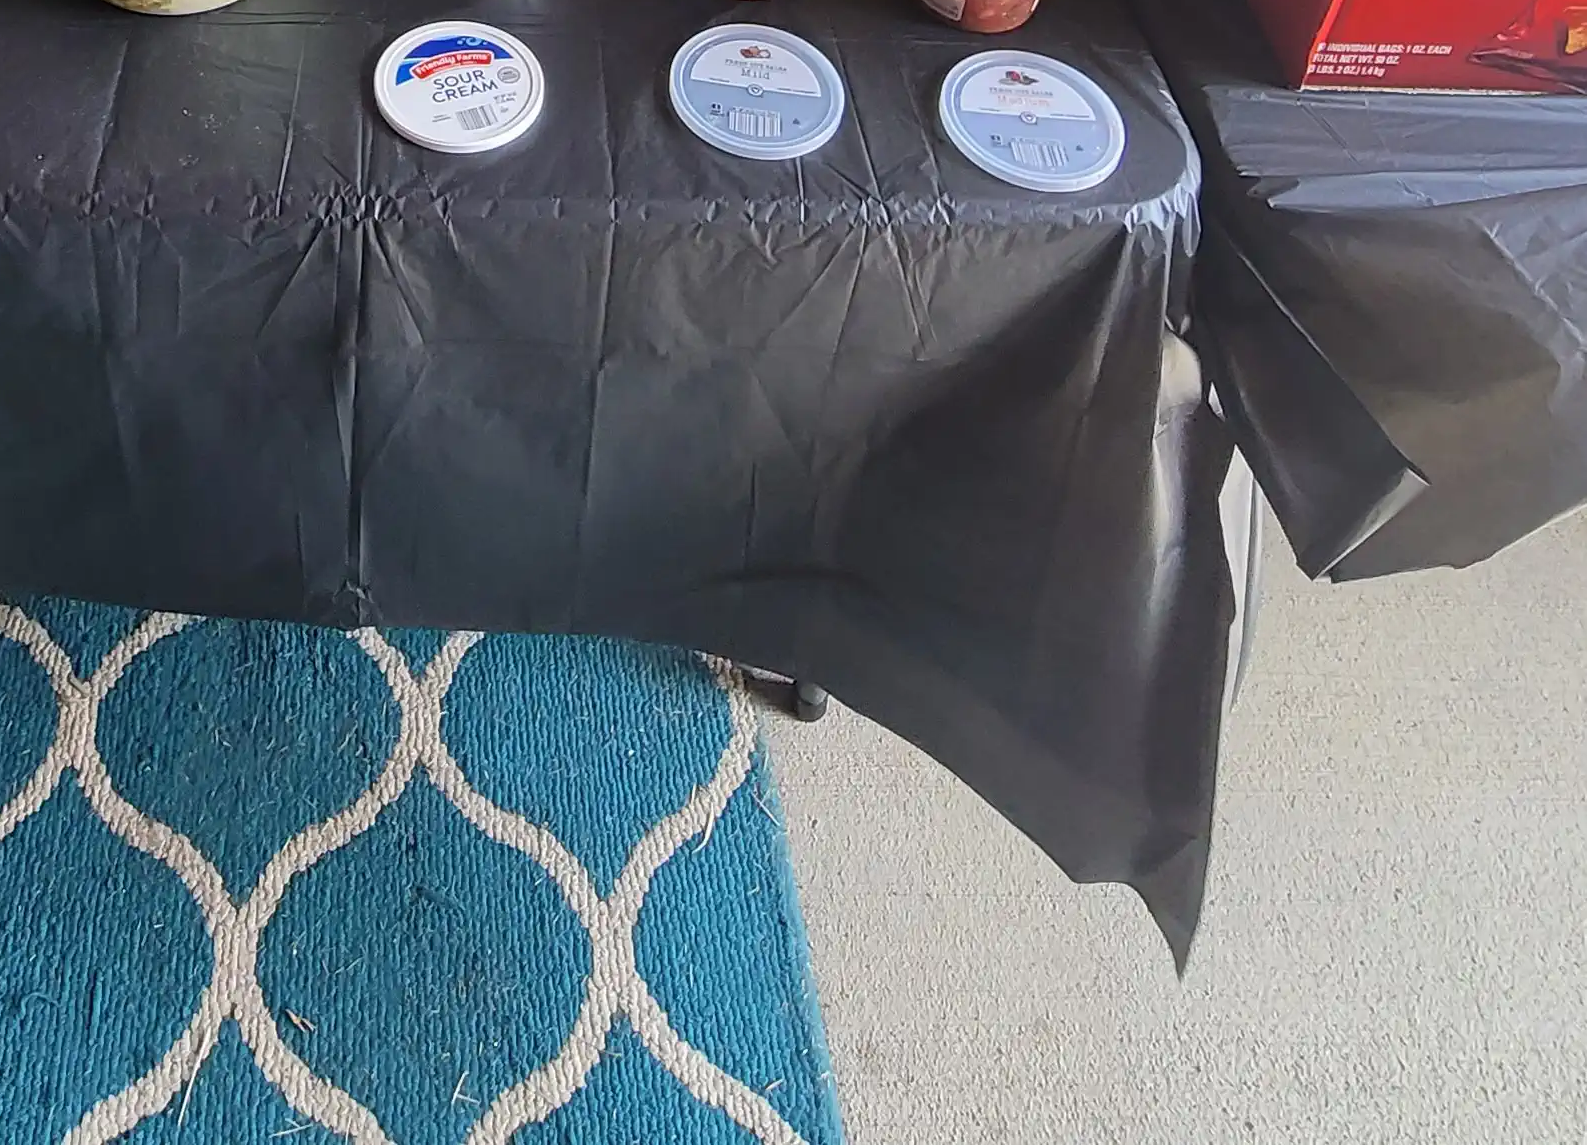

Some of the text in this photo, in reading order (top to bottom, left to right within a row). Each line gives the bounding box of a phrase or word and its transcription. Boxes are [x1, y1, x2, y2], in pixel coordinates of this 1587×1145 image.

[1327, 43, 1376, 52] INDIVIDUAL
[1427, 45, 1453, 55] EACH
[415, 53, 488, 75] Friendly Farms
[1312, 53, 1338, 63] TOTAL
[1339, 54, 1358, 64] NET
[433, 70, 486, 90] SOUR
[741, 68, 770, 80] Mild
[432, 80, 499, 103] CREAM
